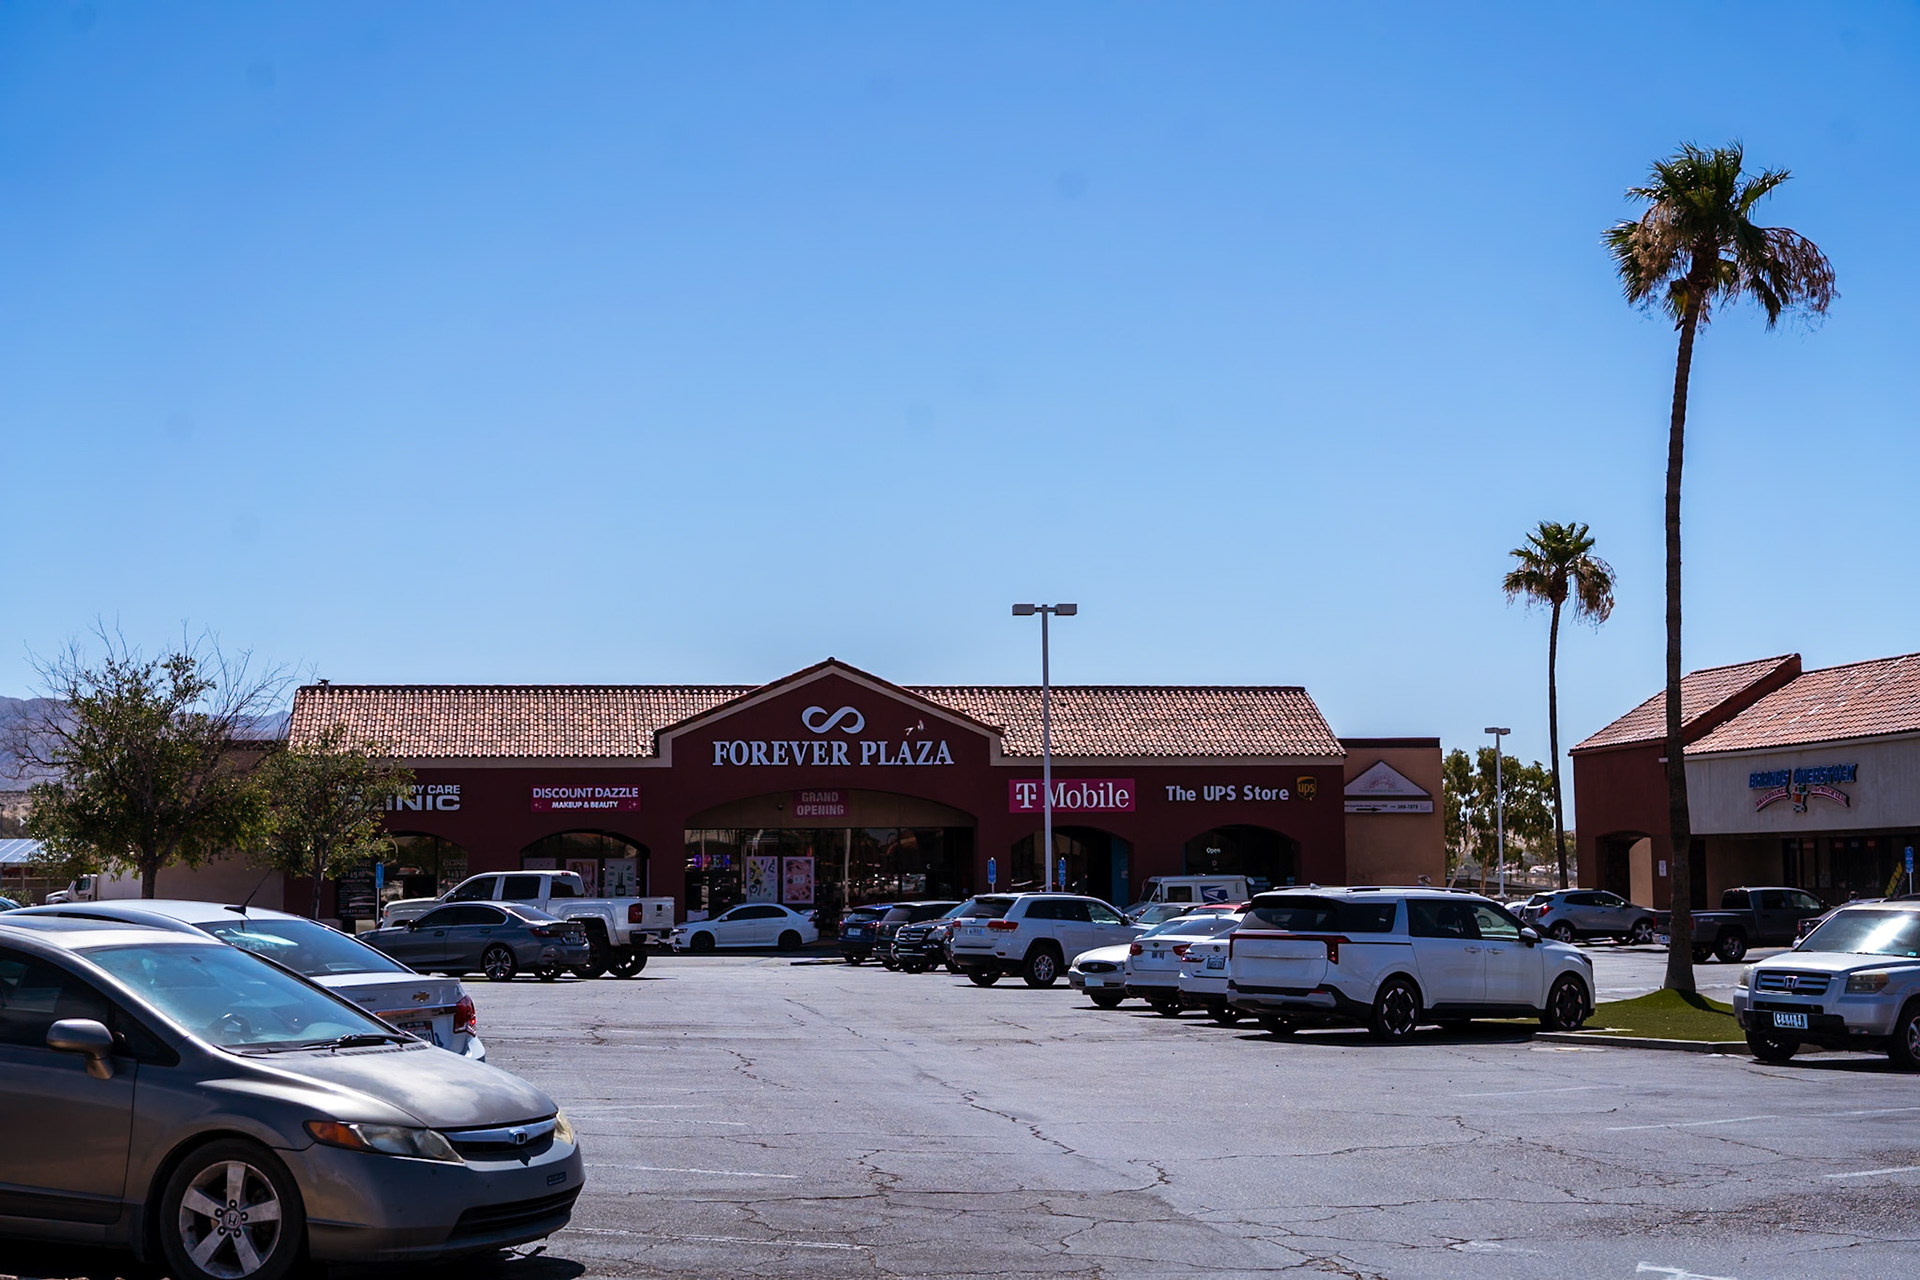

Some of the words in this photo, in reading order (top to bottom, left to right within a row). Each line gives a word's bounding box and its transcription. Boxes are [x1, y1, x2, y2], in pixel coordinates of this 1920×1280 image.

[712, 740, 851, 766] FOREVER
[859, 740, 955, 766] PLAZA
[1749, 769, 1790, 788] BRANDS
[1793, 764, 1856, 785] OVERSTOCK
[427, 784, 461, 794] CARE
[532, 787, 593, 799] DISCOUNT
[594, 787, 639, 799] DAZZLE
[1165, 785, 1196, 801] The
[1203, 785, 1236, 801] UPS
[1243, 785, 1290, 801] Store
[1298, 782, 1315, 796] ups
[801, 791, 839, 803] GRAND
[551, 801, 583, 809] MAKEUP
[583, 801, 590, 809] &
[590, 801, 618, 809] BEAUTY
[796, 804, 845, 816] OPENING
[693, 854, 732, 869] OPEN
